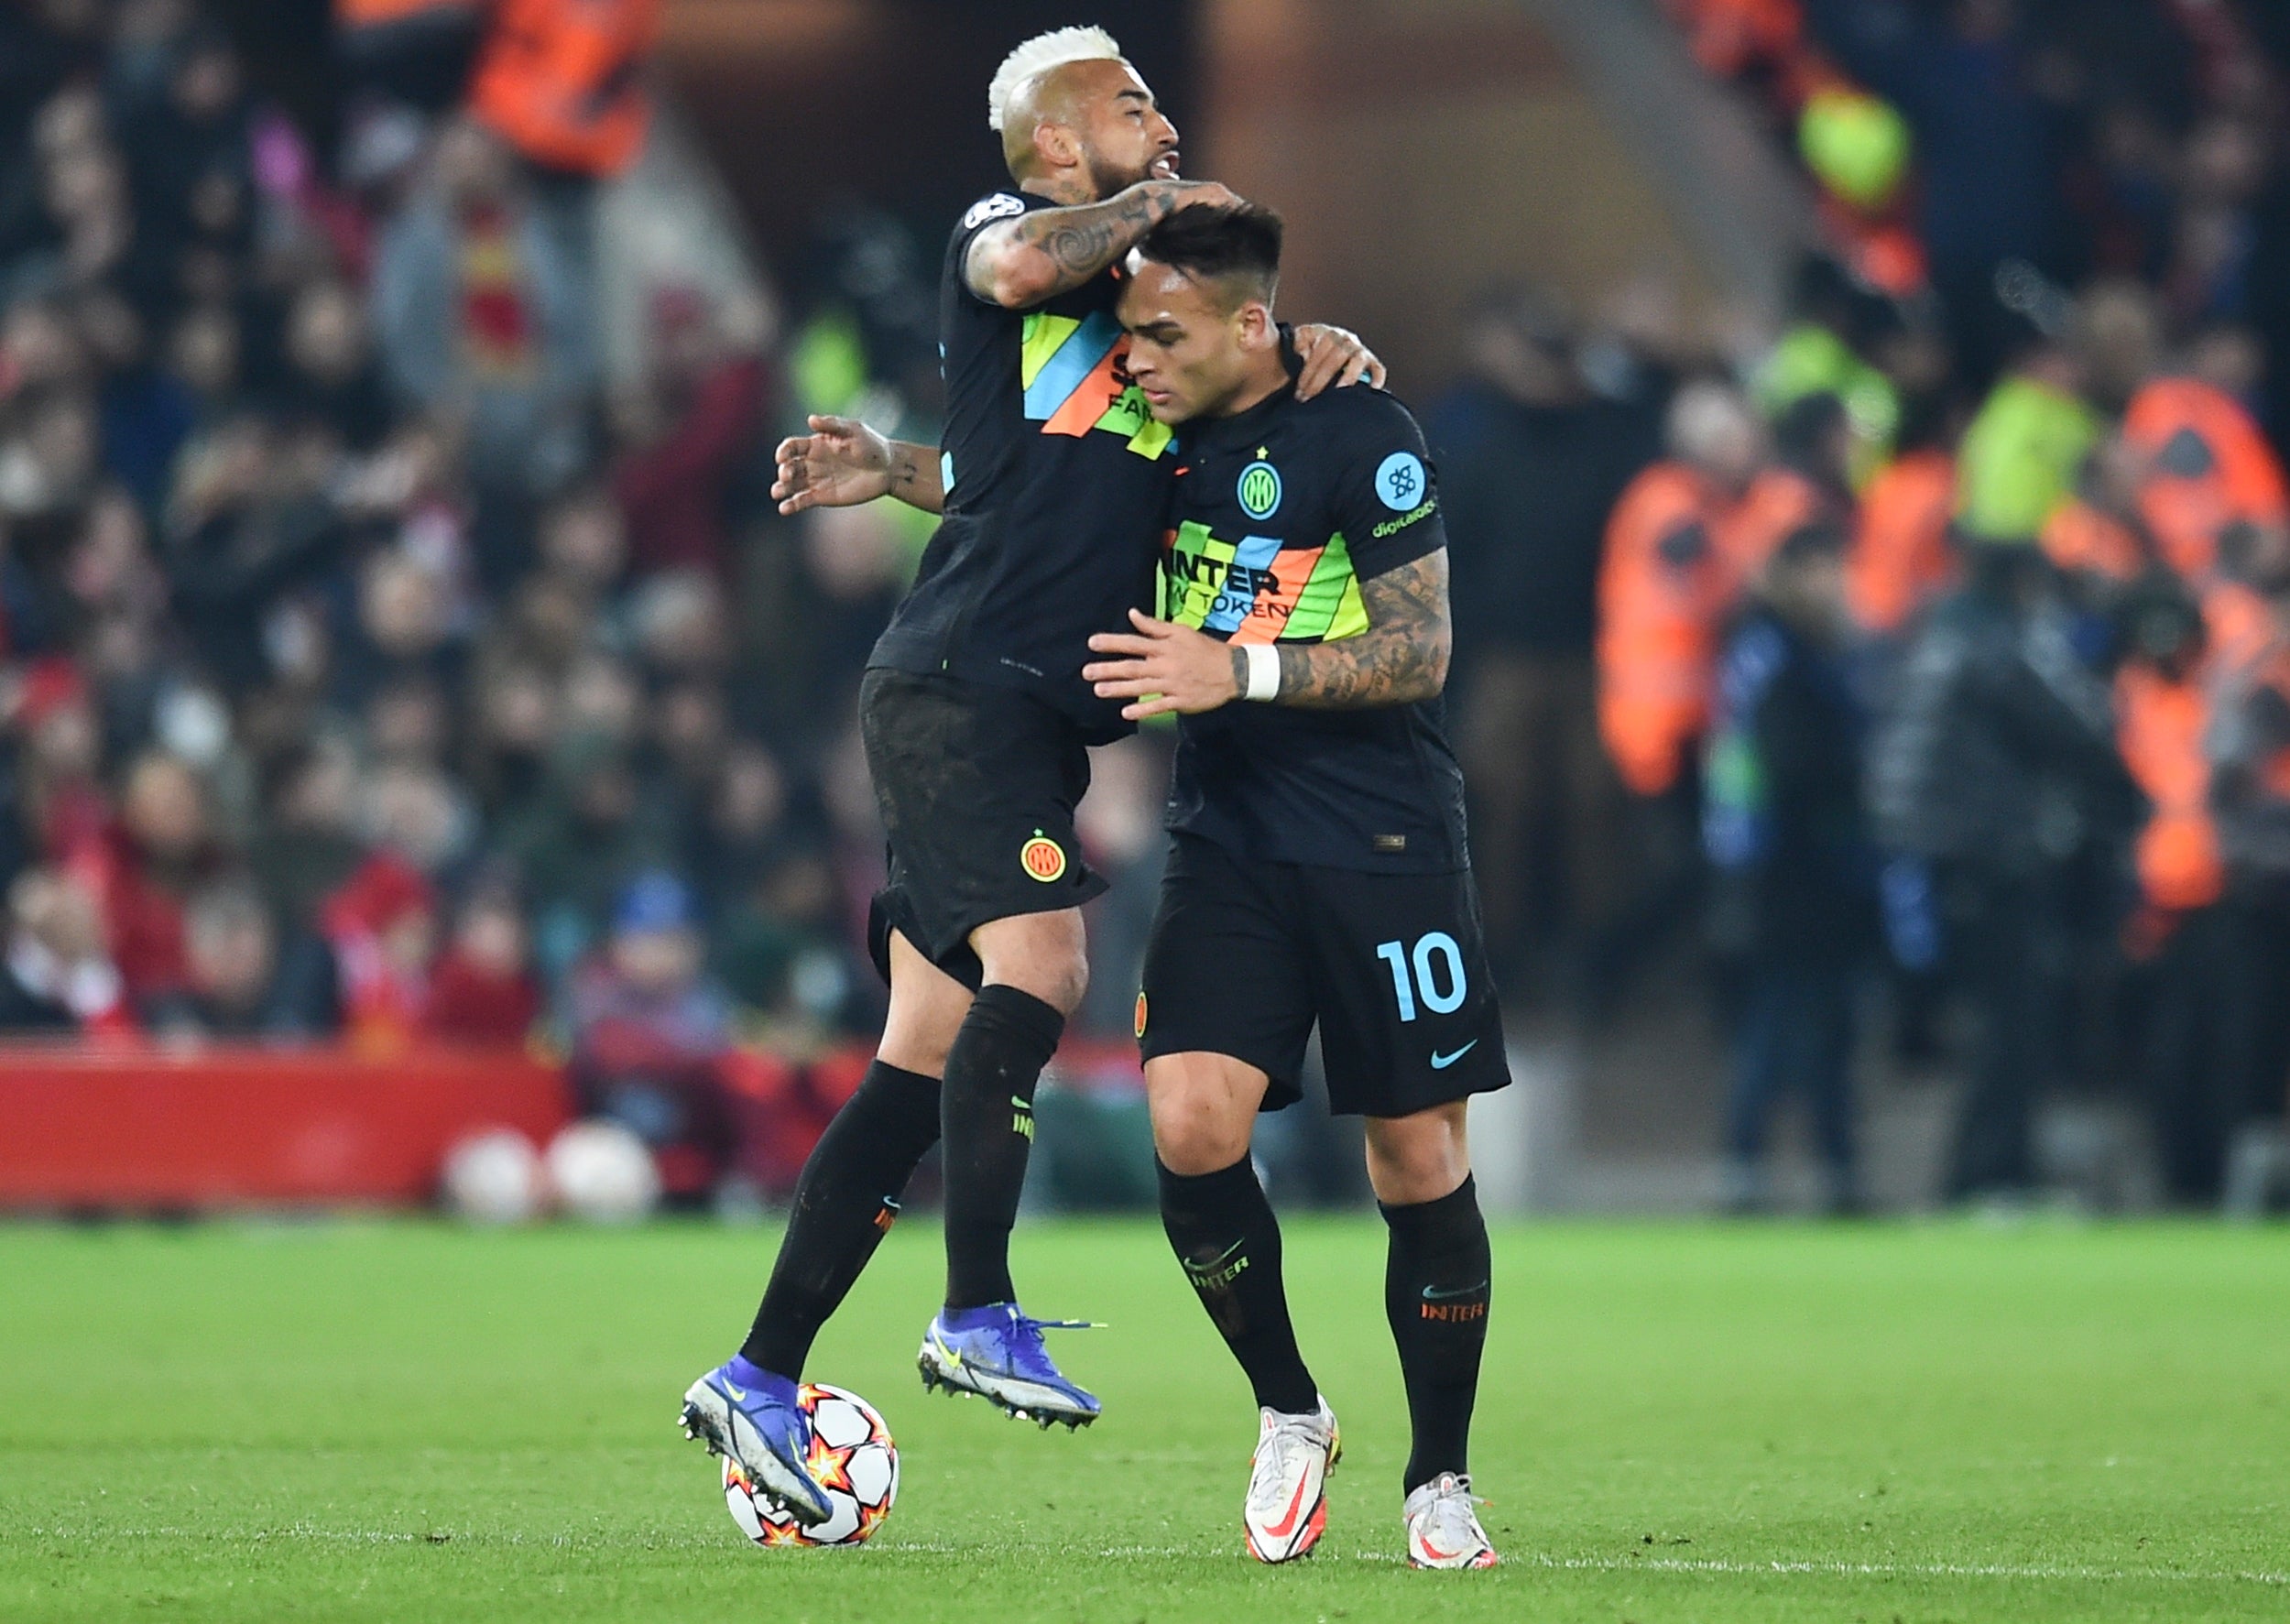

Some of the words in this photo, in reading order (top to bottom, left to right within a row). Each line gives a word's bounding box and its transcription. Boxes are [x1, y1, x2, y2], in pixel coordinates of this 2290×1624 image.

[1196, 593, 1291, 619] TOKEN
[1376, 931, 1467, 1022] 10
[1191, 1255, 1249, 1291] INTER
[1422, 1302, 1484, 1323] INTER
